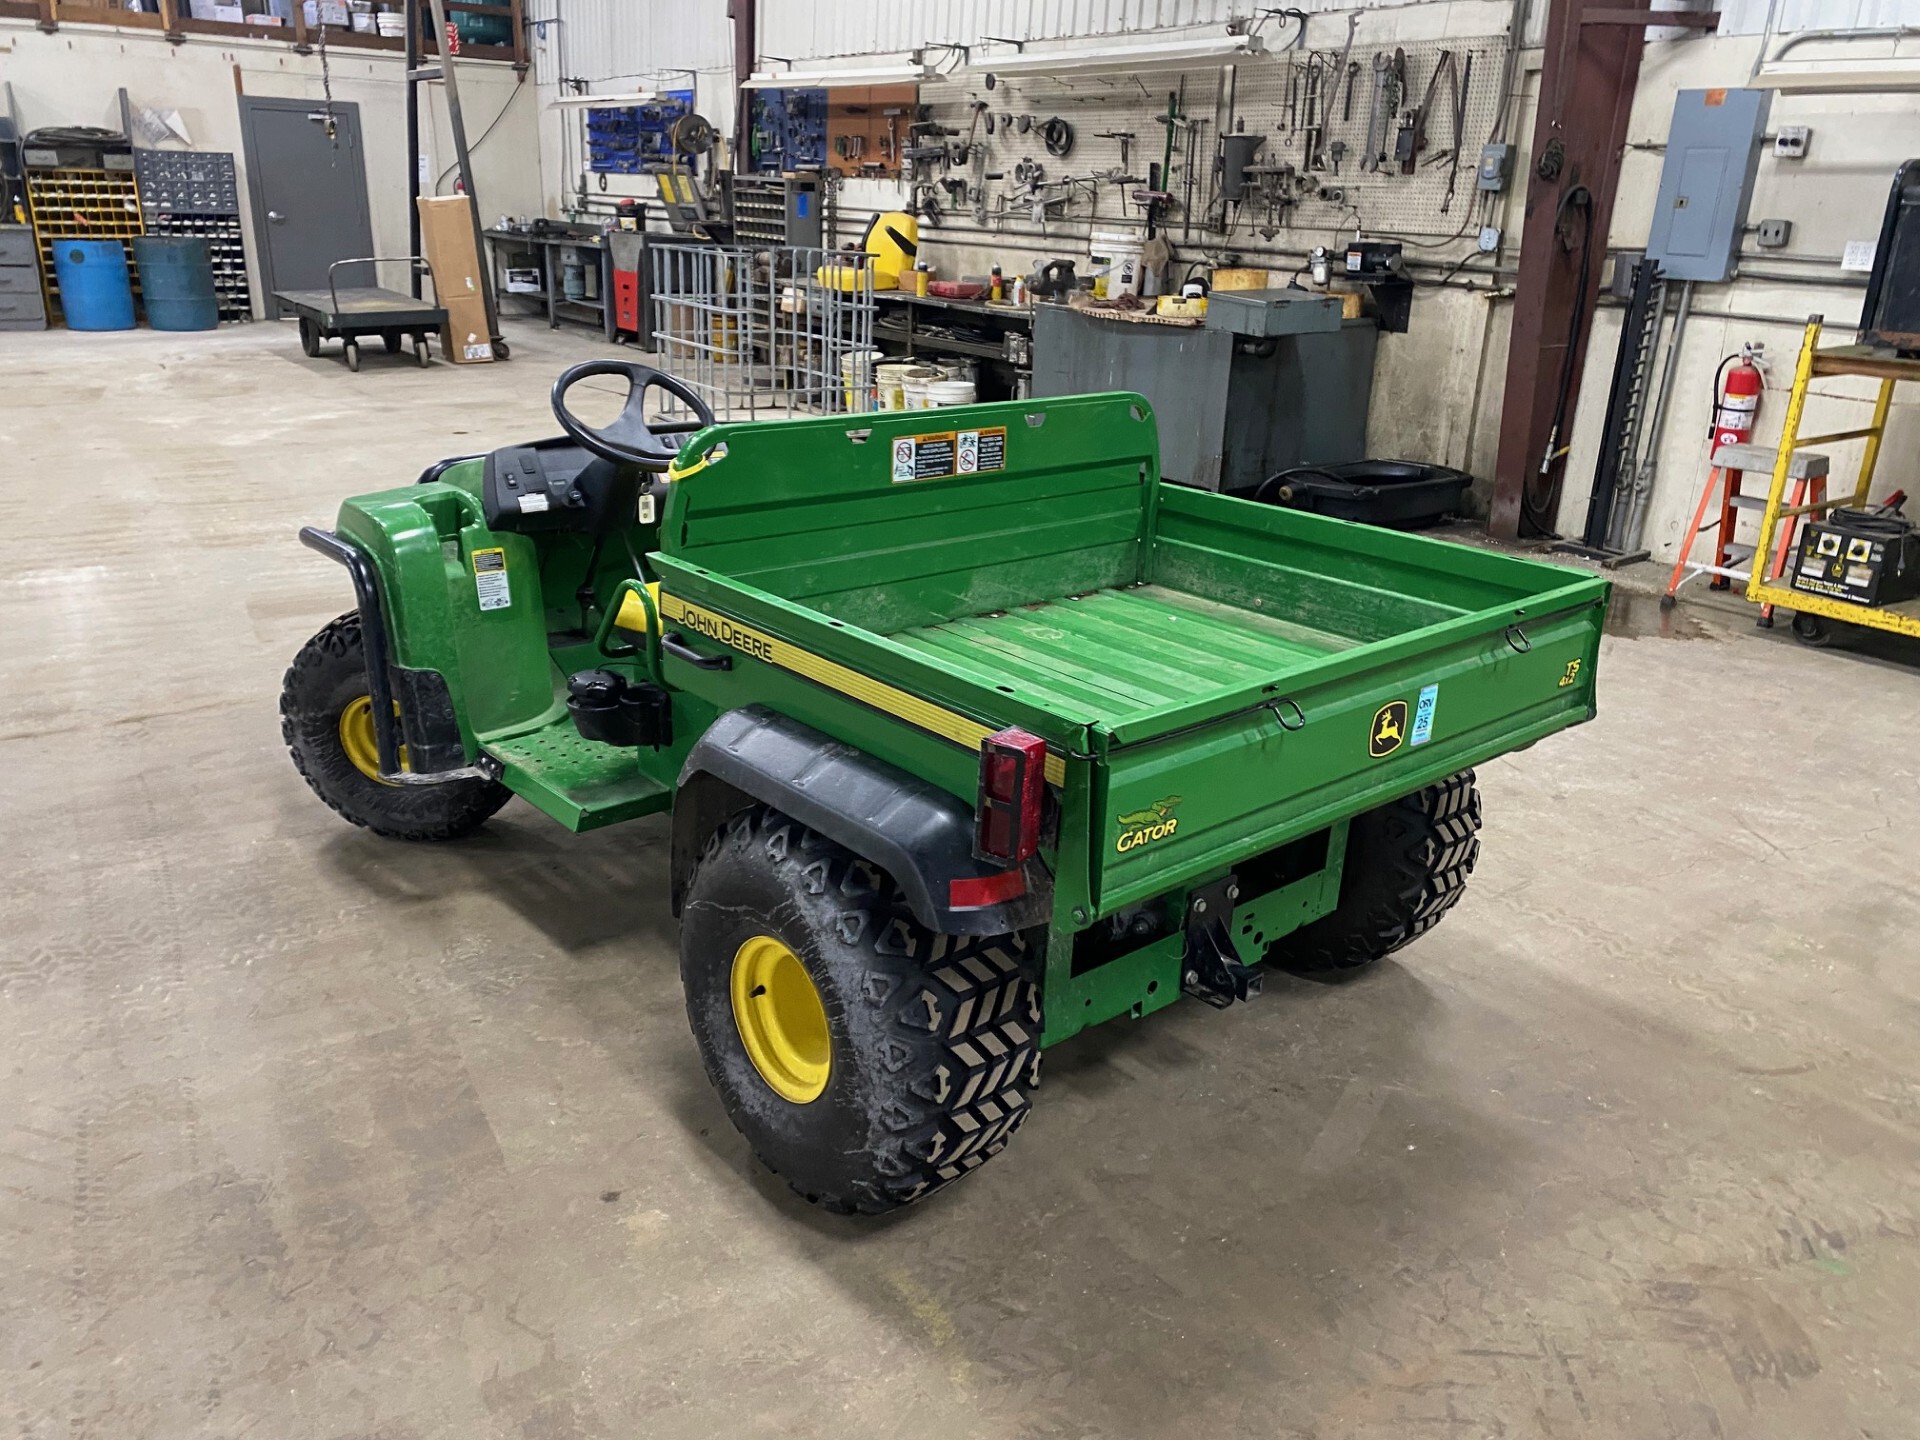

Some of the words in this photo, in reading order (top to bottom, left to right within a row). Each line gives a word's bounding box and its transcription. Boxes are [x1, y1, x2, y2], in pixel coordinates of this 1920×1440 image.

[678, 604, 717, 637] JOHN
[721, 621, 772, 661] DEERE
[1567, 658, 1581, 676] TS
[1419, 697, 1434, 710] ORV
[1417, 717, 1428, 730] 25
[1116, 818, 1178, 852] GATOR
